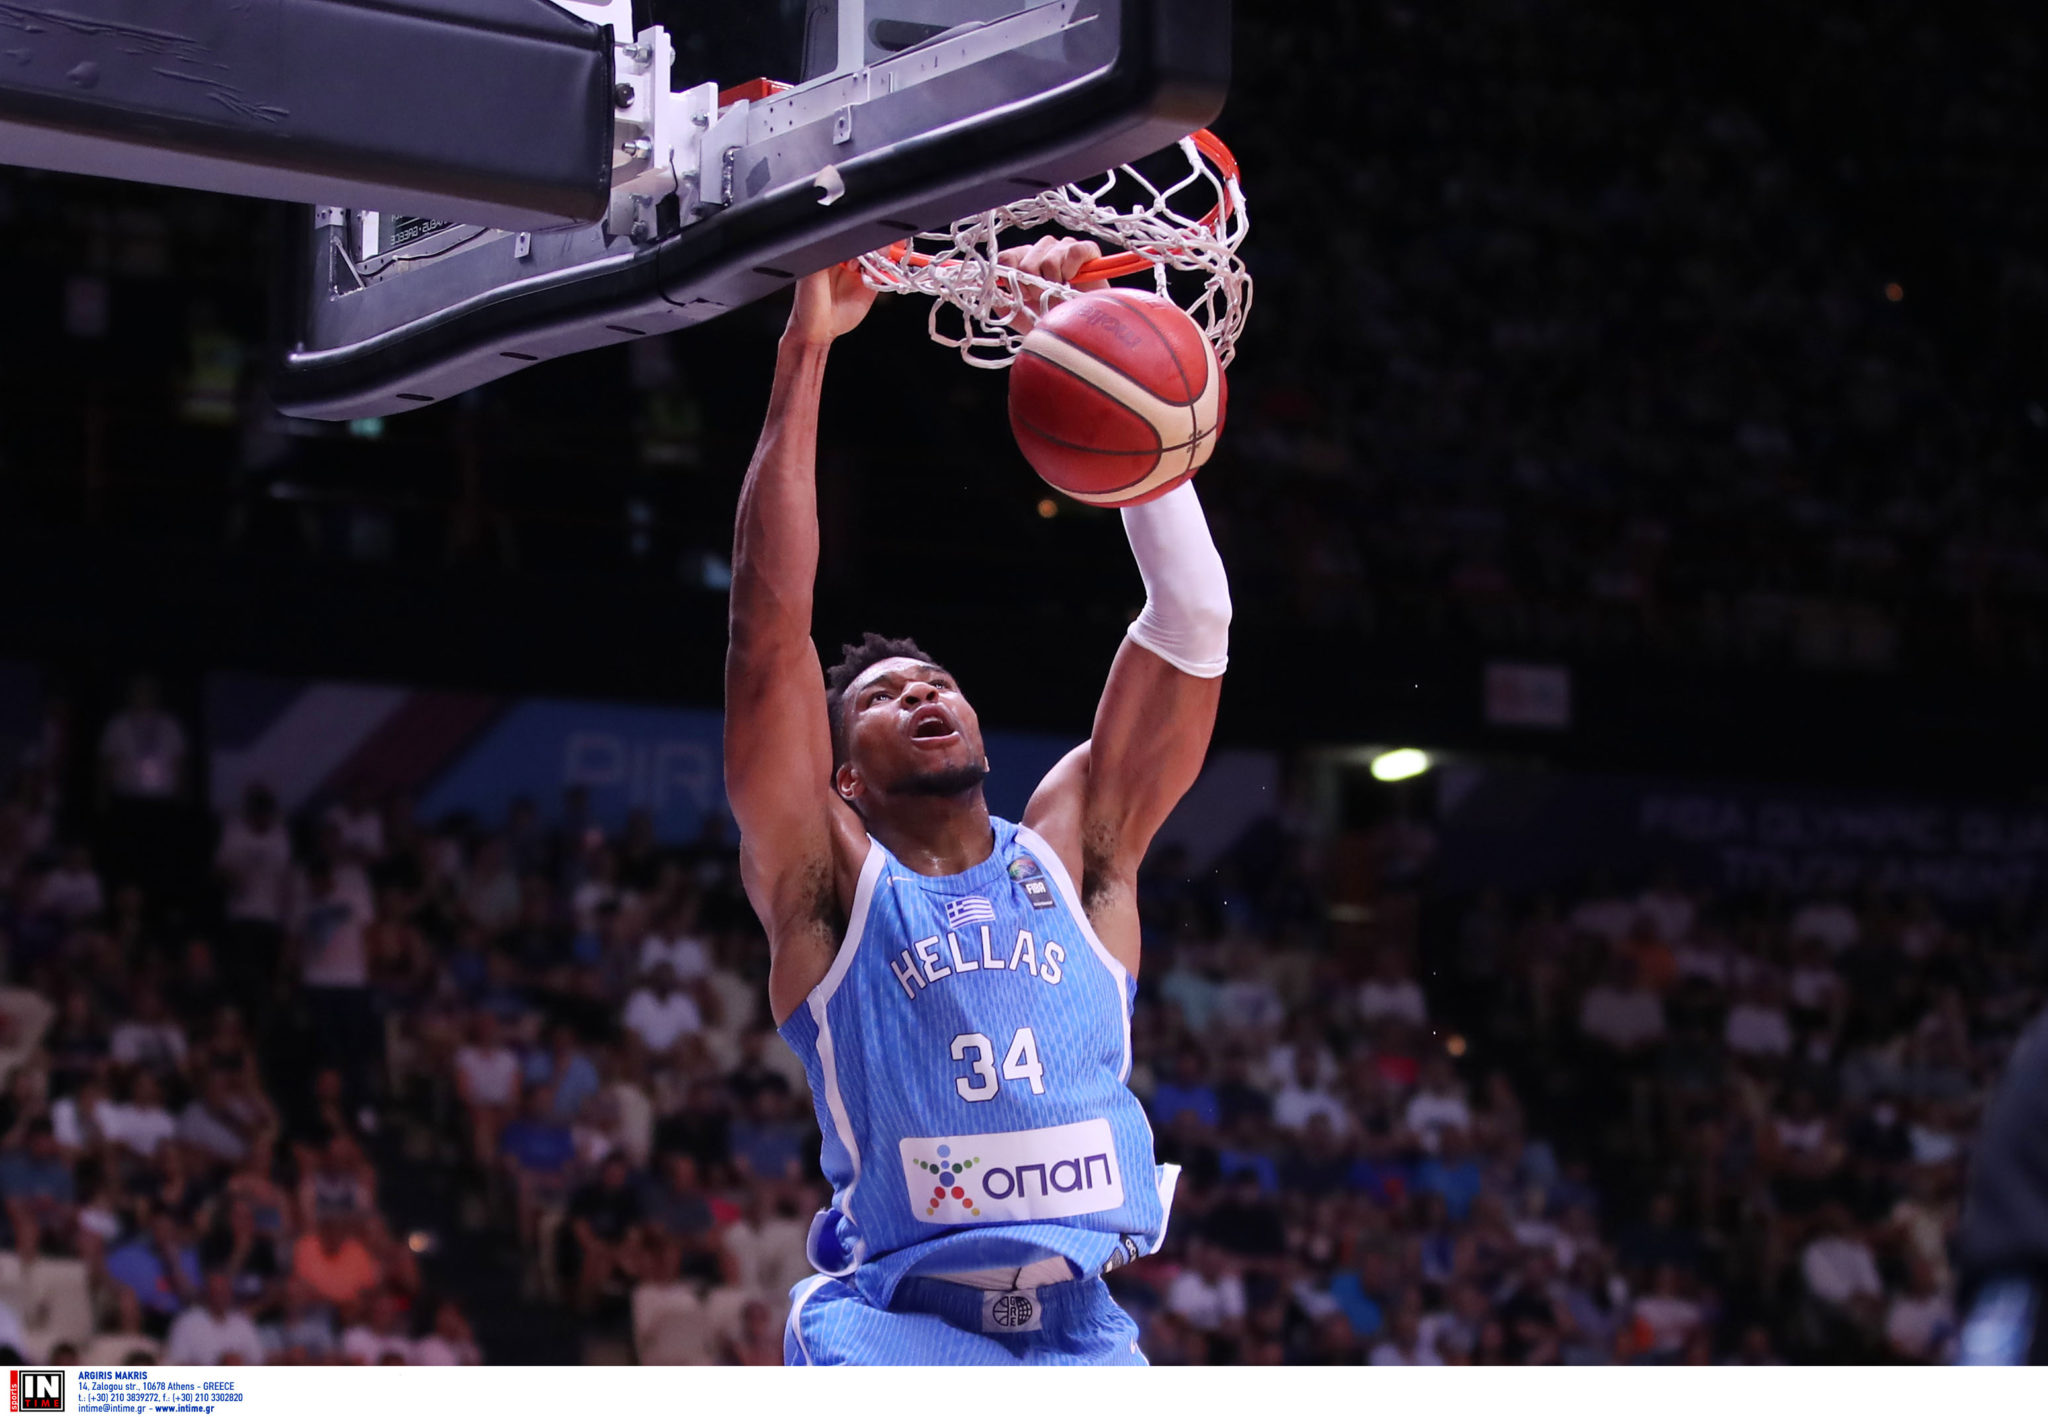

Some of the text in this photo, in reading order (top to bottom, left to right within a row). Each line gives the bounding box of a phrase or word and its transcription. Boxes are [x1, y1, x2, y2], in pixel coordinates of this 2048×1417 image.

[565, 732, 736, 812] PIR
[1025, 881, 1047, 895] FIBA
[890, 925, 1066, 1000] HELLAS
[950, 1027, 1045, 1102] 34
